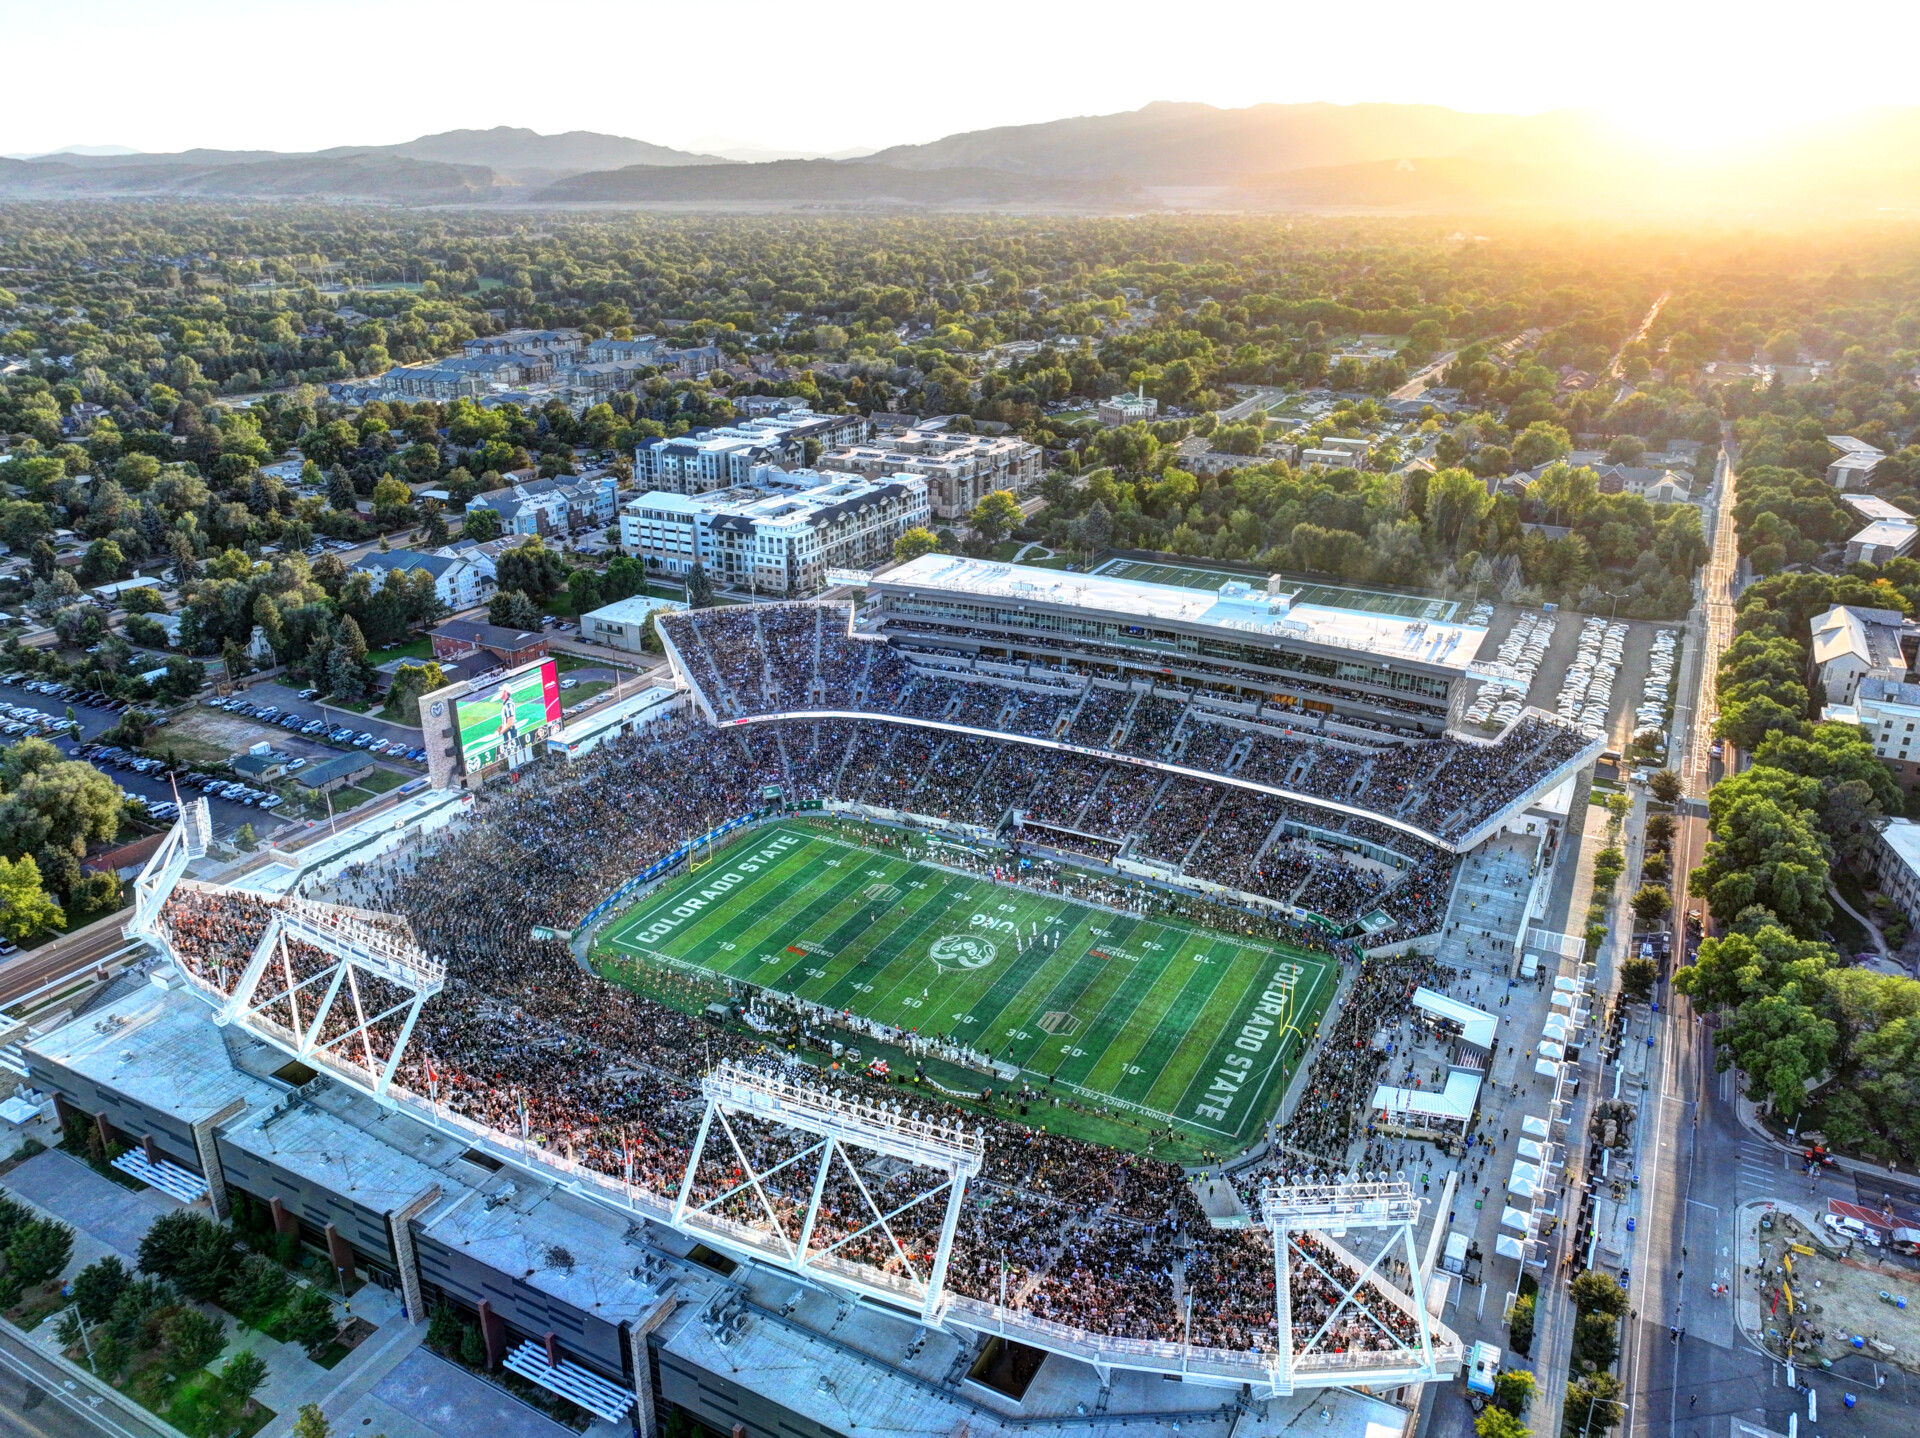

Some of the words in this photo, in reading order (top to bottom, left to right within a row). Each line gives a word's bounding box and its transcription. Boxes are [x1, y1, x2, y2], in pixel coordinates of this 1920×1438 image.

[1116, 660, 1142, 669] canvas
[525, 733, 530, 743] 0
[485, 751, 491, 760] 3
[868, 870, 886, 878] 20
[636, 872, 744, 944] COLORADO
[738, 835, 799, 873] STATE
[910, 881, 928, 889] 30
[998, 904, 1016, 913] 50
[1093, 928, 1112, 938] 30
[1190, 928, 1213, 939] FIELD
[1216, 933, 1244, 945] LUBICK
[720, 942, 737, 950] 10
[796, 942, 834, 958] canvas
[1142, 941, 1162, 950] 20
[1246, 942, 1274, 952] SONNY
[760, 955, 781, 964] 20
[1096, 947, 1139, 962] canvas
[805, 968, 826, 978] 30
[853, 983, 874, 993] 40
[902, 997, 923, 1008] 50
[1234, 962, 1304, 1053] COLORADO
[952, 1013, 974, 1024] 40
[1006, 1028, 1027, 1040] 30
[1060, 1045, 1083, 1057] 20
[1122, 1063, 1141, 1075] 10
[1195, 1053, 1253, 1121] STATE
[1072, 1087, 1100, 1100] FIELD
[1101, 1097, 1136, 1114] LUBICK
[1138, 1110, 1173, 1123] SONNY
